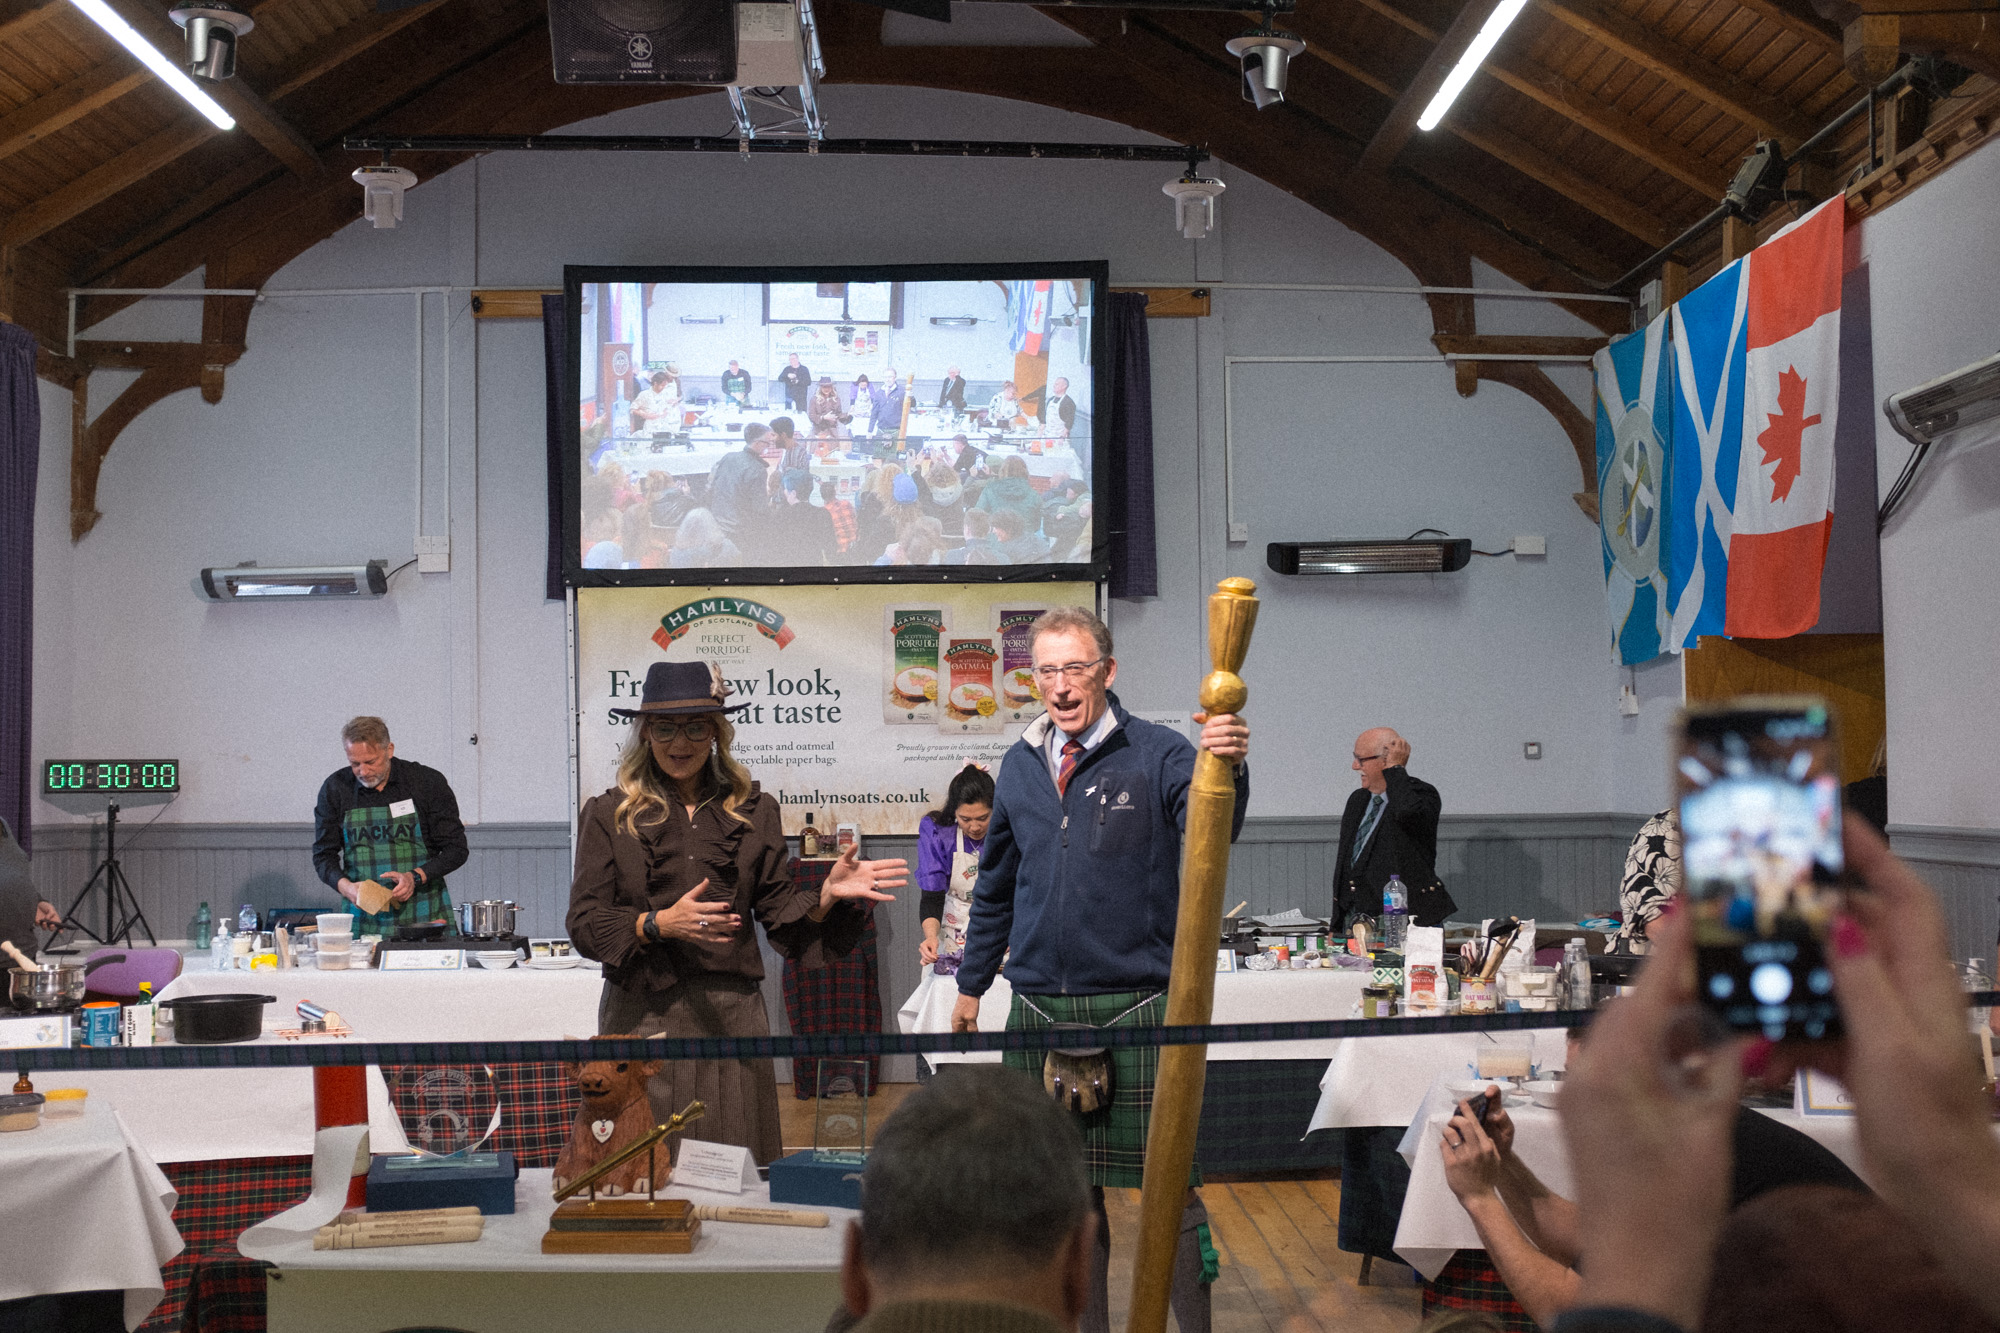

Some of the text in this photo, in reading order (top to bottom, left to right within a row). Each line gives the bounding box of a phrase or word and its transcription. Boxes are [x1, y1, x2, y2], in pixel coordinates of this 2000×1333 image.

[630, 61, 653, 69] YAMAHA
[668, 600, 778, 627] HAMLYNS
[708, 617, 754, 628] SCOTLAND
[896, 615, 940, 626] HAMLYNS
[1003, 615, 1037, 627] HAMLY
[701, 634, 746, 645] PERFECT
[1002, 639, 1027, 648] PORR
[695, 645, 751, 656] PORRIDGE
[949, 644, 993, 655] HAMLYNS
[951, 662, 991, 670] OATMEAL
[767, 668, 841, 700] look,
[773, 703, 842, 724] taste
[753, 743, 774, 752] oats
[776, 742, 793, 751] and
[796, 741, 835, 751] oatmeal
[896, 743, 926, 752] Proudly
[926, 744, 949, 753] grown
[958, 742, 991, 751] Scotland.
[737, 755, 784, 768] recyclable
[785, 757, 813, 768] paper
[815, 755, 839, 767] bags.
[904, 754, 938, 763] packaged
[938, 753, 955, 761] with
[779, 788, 930, 809] hamlynsoats.co.uk
[346, 823, 417, 842] MACKAY
